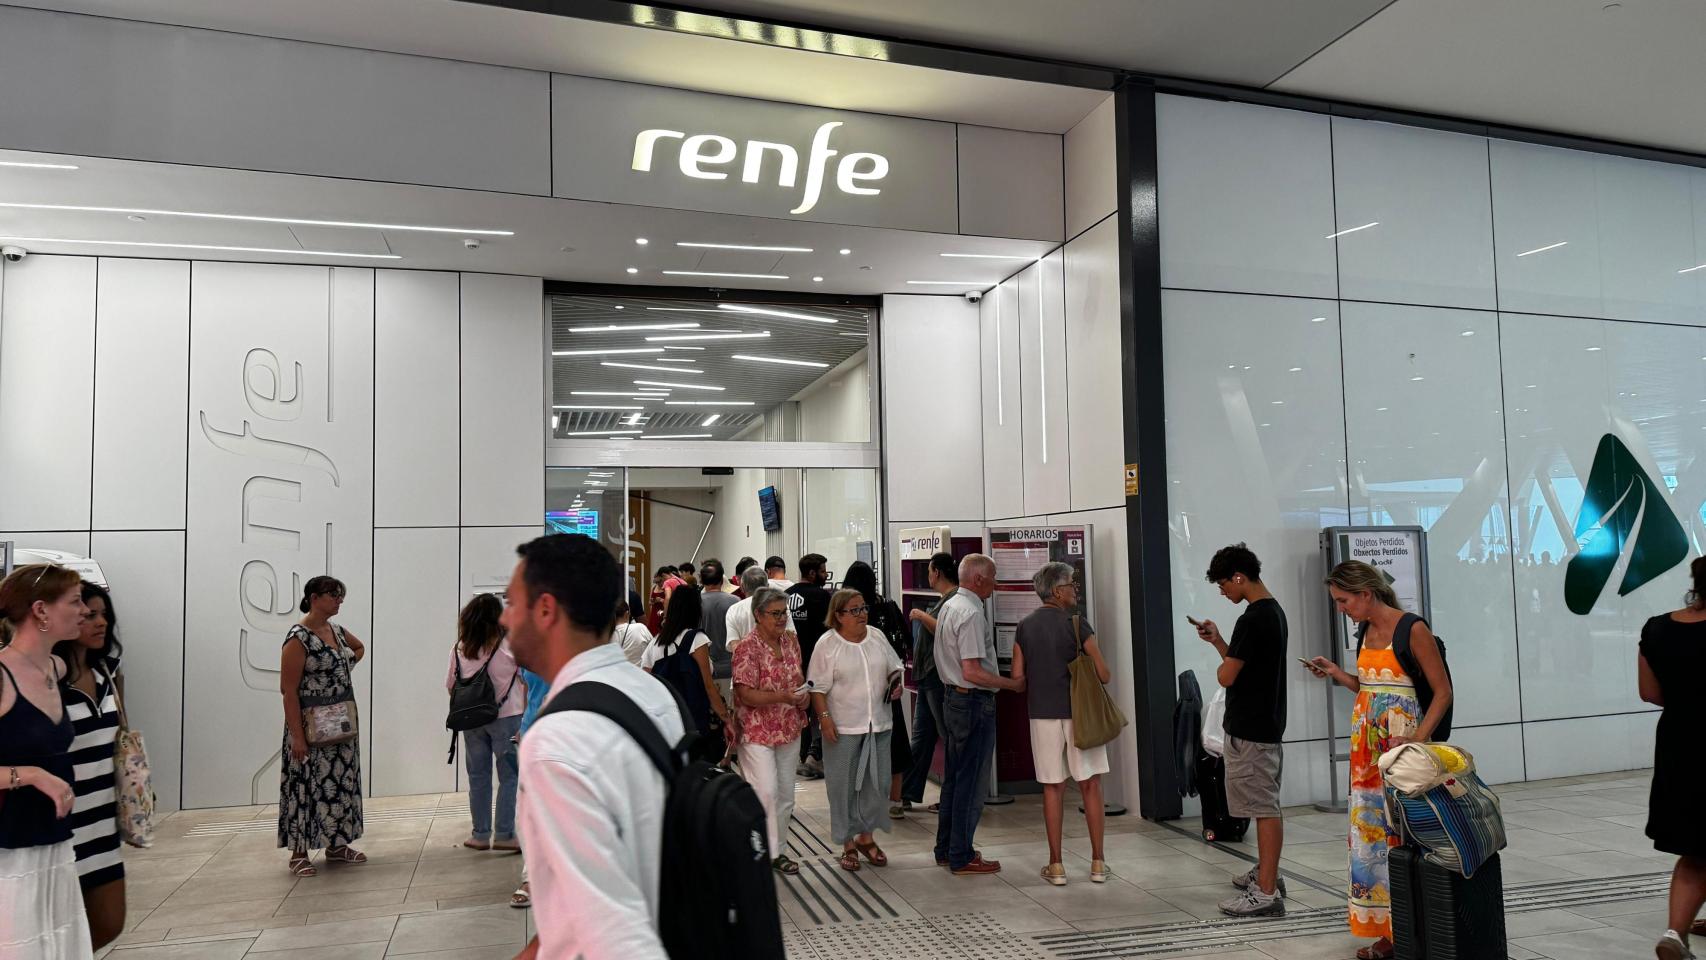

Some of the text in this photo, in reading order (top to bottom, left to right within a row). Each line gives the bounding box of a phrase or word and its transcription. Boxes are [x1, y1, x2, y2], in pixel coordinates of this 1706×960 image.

[632, 121, 889, 214] renfe
[200, 348, 340, 692] renfe
[918, 530, 940, 555] renfe
[1009, 529, 1058, 539] HORARIOS
[1355, 538, 1404, 548] Objetos Perdidos
